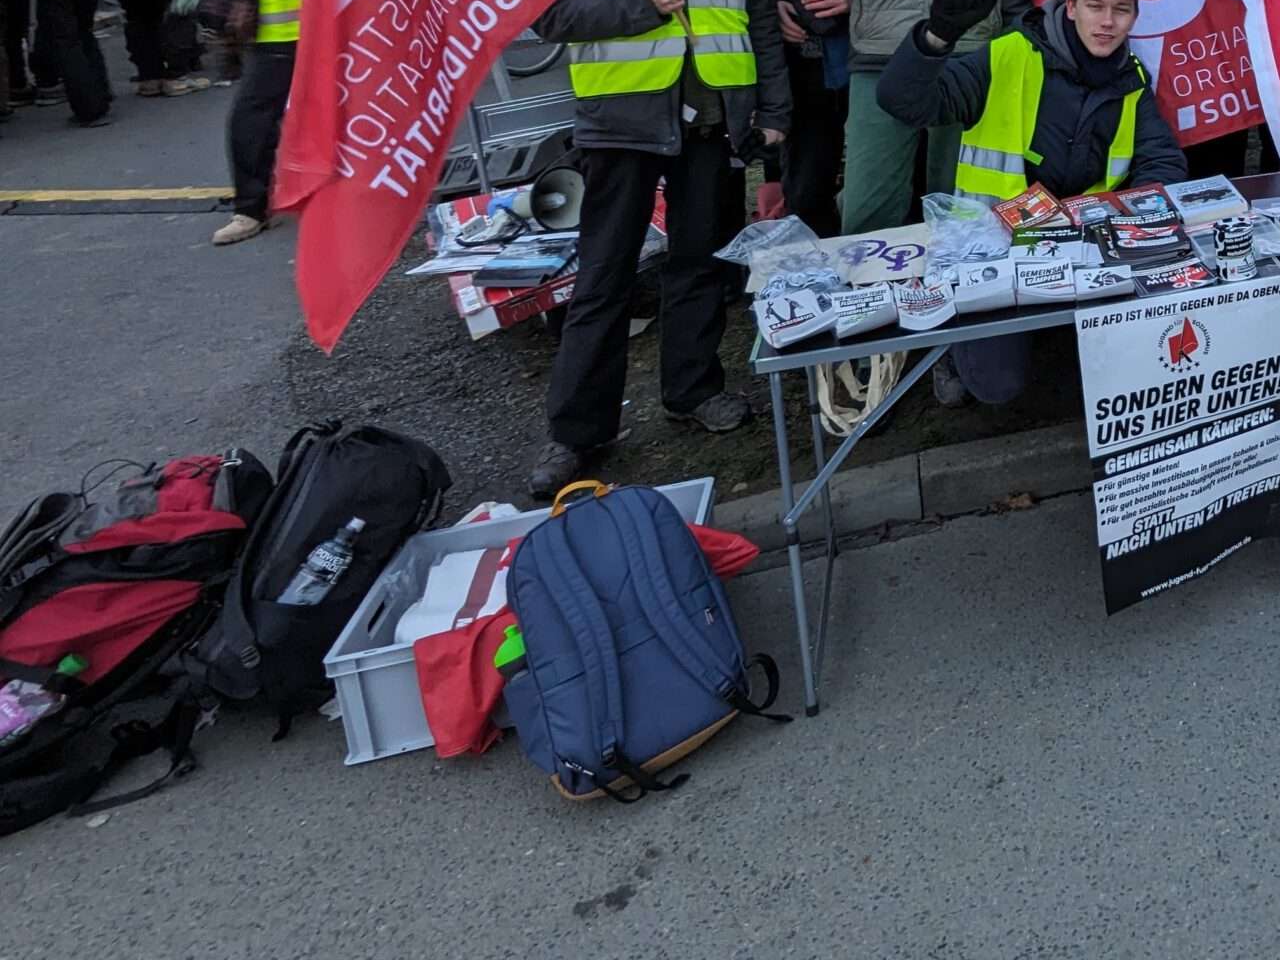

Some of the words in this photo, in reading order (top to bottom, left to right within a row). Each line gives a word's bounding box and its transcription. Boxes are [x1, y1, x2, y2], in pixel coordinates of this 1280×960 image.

[1019, 262, 1070, 278] GEMEINSAM
[1081, 317, 1100, 330] DIE
[1102, 313, 1123, 327] AFD
[1125, 309, 1143, 322] IST
[1145, 303, 1178, 318] NICHT
[1180, 296, 1215, 311] GEGEN
[1217, 292, 1235, 305] DIE
[1236, 290, 1250, 302] DA
[1095, 374, 1205, 421] SONDERN
[1096, 414, 1145, 445] UNS
[1151, 395, 1202, 431] HIER
[1104, 430, 1199, 475] GEMEINSAM
[1201, 407, 1275, 443] KÄMPFEN:
[1104, 483, 1116, 492] Für
[1117, 471, 1150, 487] günstige
[1152, 461, 1180, 477] Mieten!
[1105, 494, 1117, 503] Für
[1120, 484, 1150, 498] massive
[1151, 465, 1199, 488] Investitionen
[1200, 462, 1208, 472] in
[1208, 454, 1232, 469] unsere
[1105, 503, 1118, 514] Für
[1119, 498, 1133, 510] gut
[1134, 487, 1167, 505] bezahlte
[1106, 515, 1120, 526] Für
[1121, 509, 1137, 521] eine
[1138, 492, 1189, 514] sozialistische
[1190, 480, 1216, 497] Zukunft
[1106, 530, 1151, 561] NACH
[1154, 510, 1204, 541] UNTEN
[1206, 498, 1224, 521] ZU
[1226, 475, 1280, 509] TRETEN!
[1133, 508, 1174, 534] STATT
